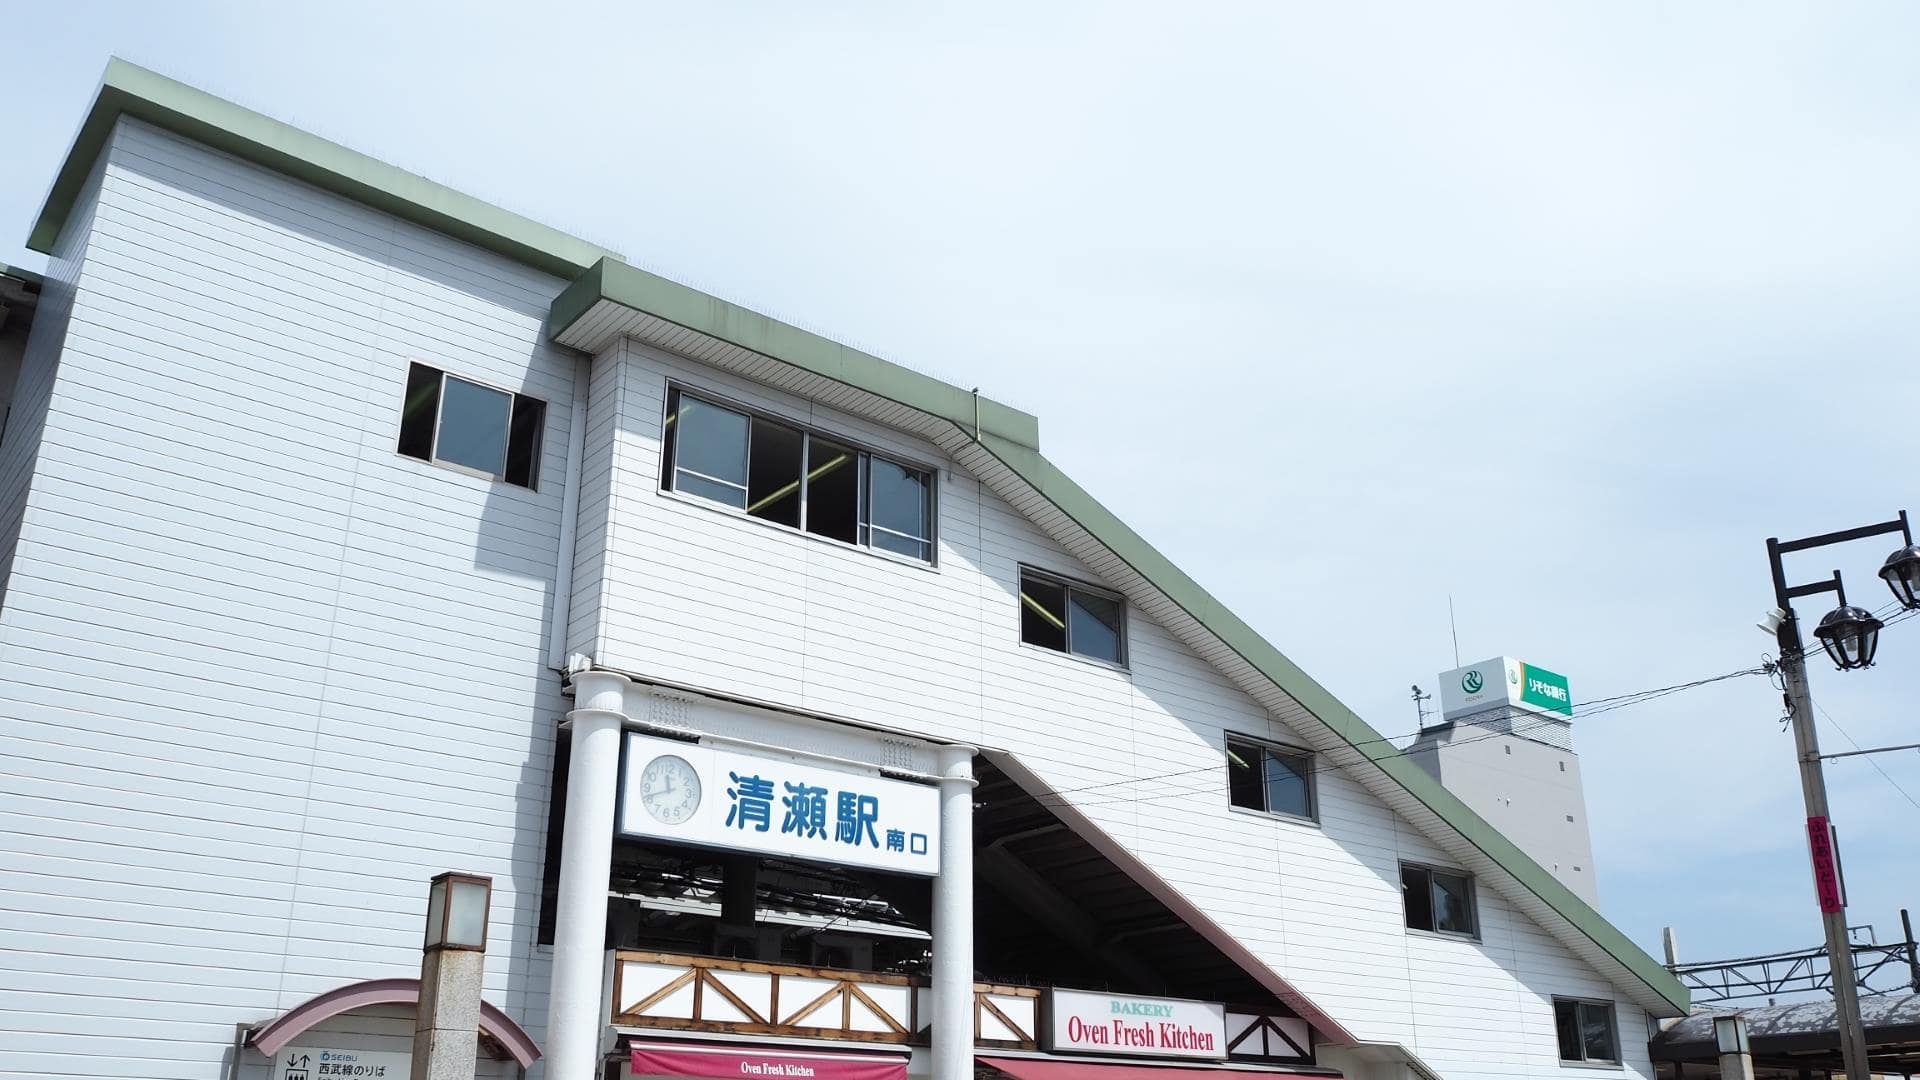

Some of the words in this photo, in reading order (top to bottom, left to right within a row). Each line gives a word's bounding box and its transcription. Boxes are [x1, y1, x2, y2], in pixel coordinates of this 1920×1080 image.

[1528, 677, 1568, 702] りそな銀行
[643, 783, 651, 793] 9
[685, 788, 692, 799] 3
[725, 771, 880, 849] 清瀬駅
[886, 828, 928, 856] 南口
[1111, 1000, 1174, 1018] BAKERY
[1068, 1015, 1109, 1044] Oven
[1112, 1019, 1155, 1048] Fresh
[1159, 1022, 1214, 1051] Kitchen
[331, 1054, 358, 1062] SEIBU
[319, 1062, 387, 1077] 西武線のりば
[741, 1061, 761, 1074] Oven
[762, 1063, 785, 1076] Fresh
[785, 1064, 815, 1077] Kitchen
